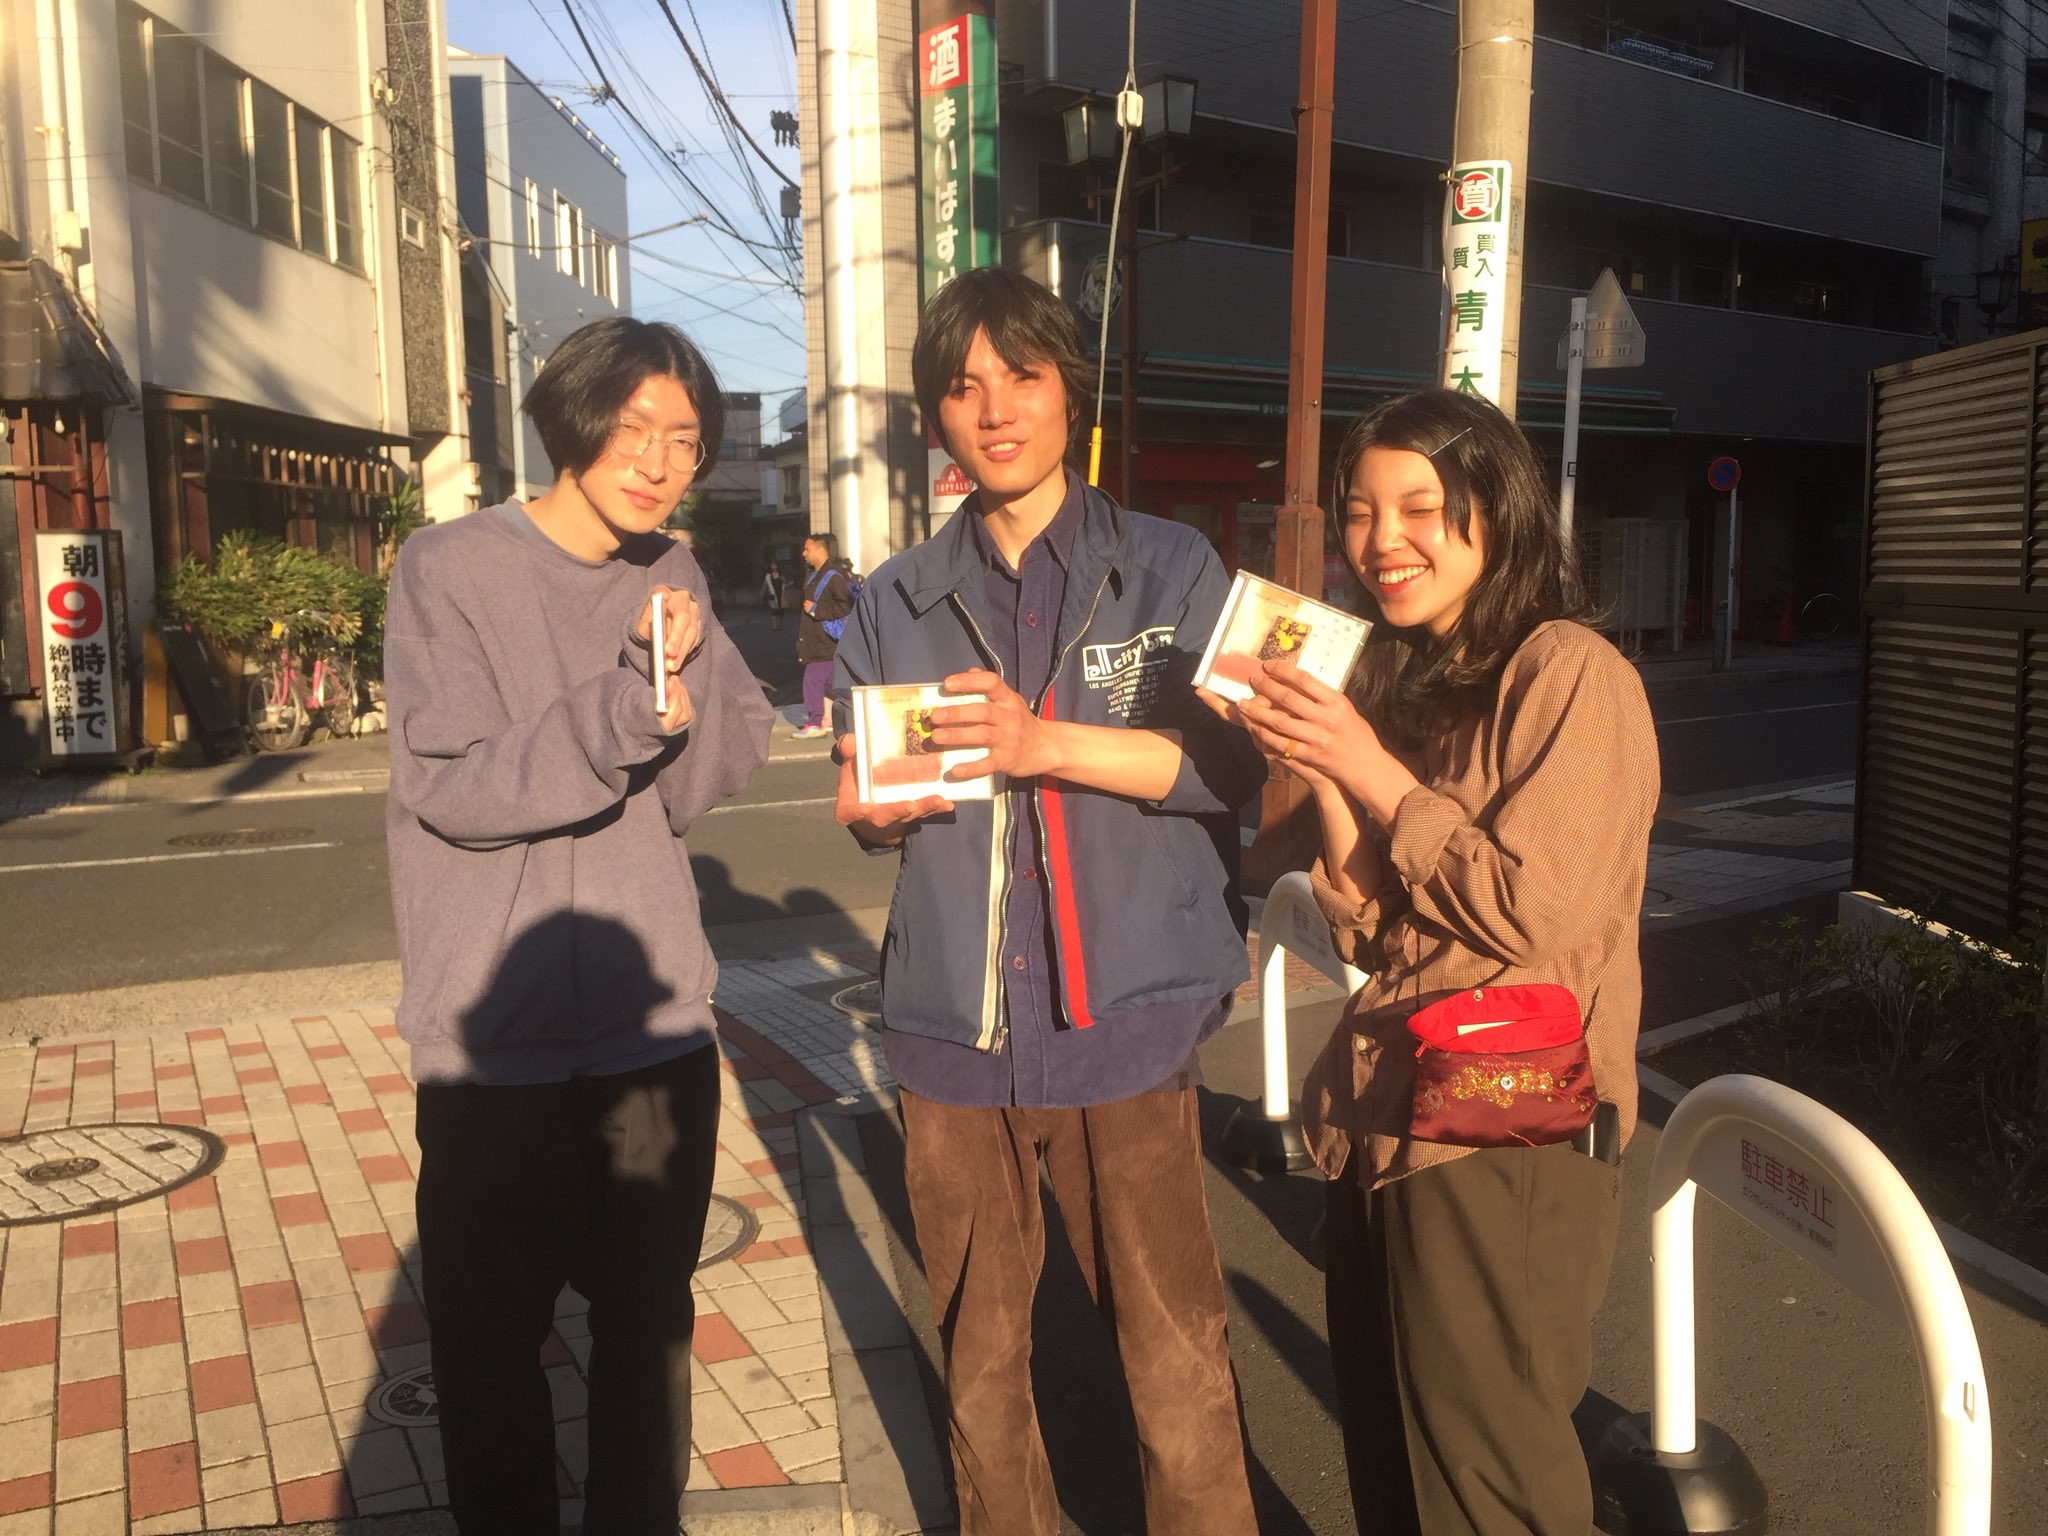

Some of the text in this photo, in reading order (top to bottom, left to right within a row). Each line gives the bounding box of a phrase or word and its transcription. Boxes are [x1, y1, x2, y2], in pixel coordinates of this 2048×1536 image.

[929, 24, 960, 87] 酒
[1461, 179, 1493, 214] 質
[1453, 247, 1469, 270] 質
[1475, 234, 1495, 277] 買入
[47, 544, 108, 739] 朝9時まで
[1113, 644, 1142, 669] city
[49, 644, 75, 742] 絶賛営業中
[1741, 1138, 1835, 1229] 駐車禁止
